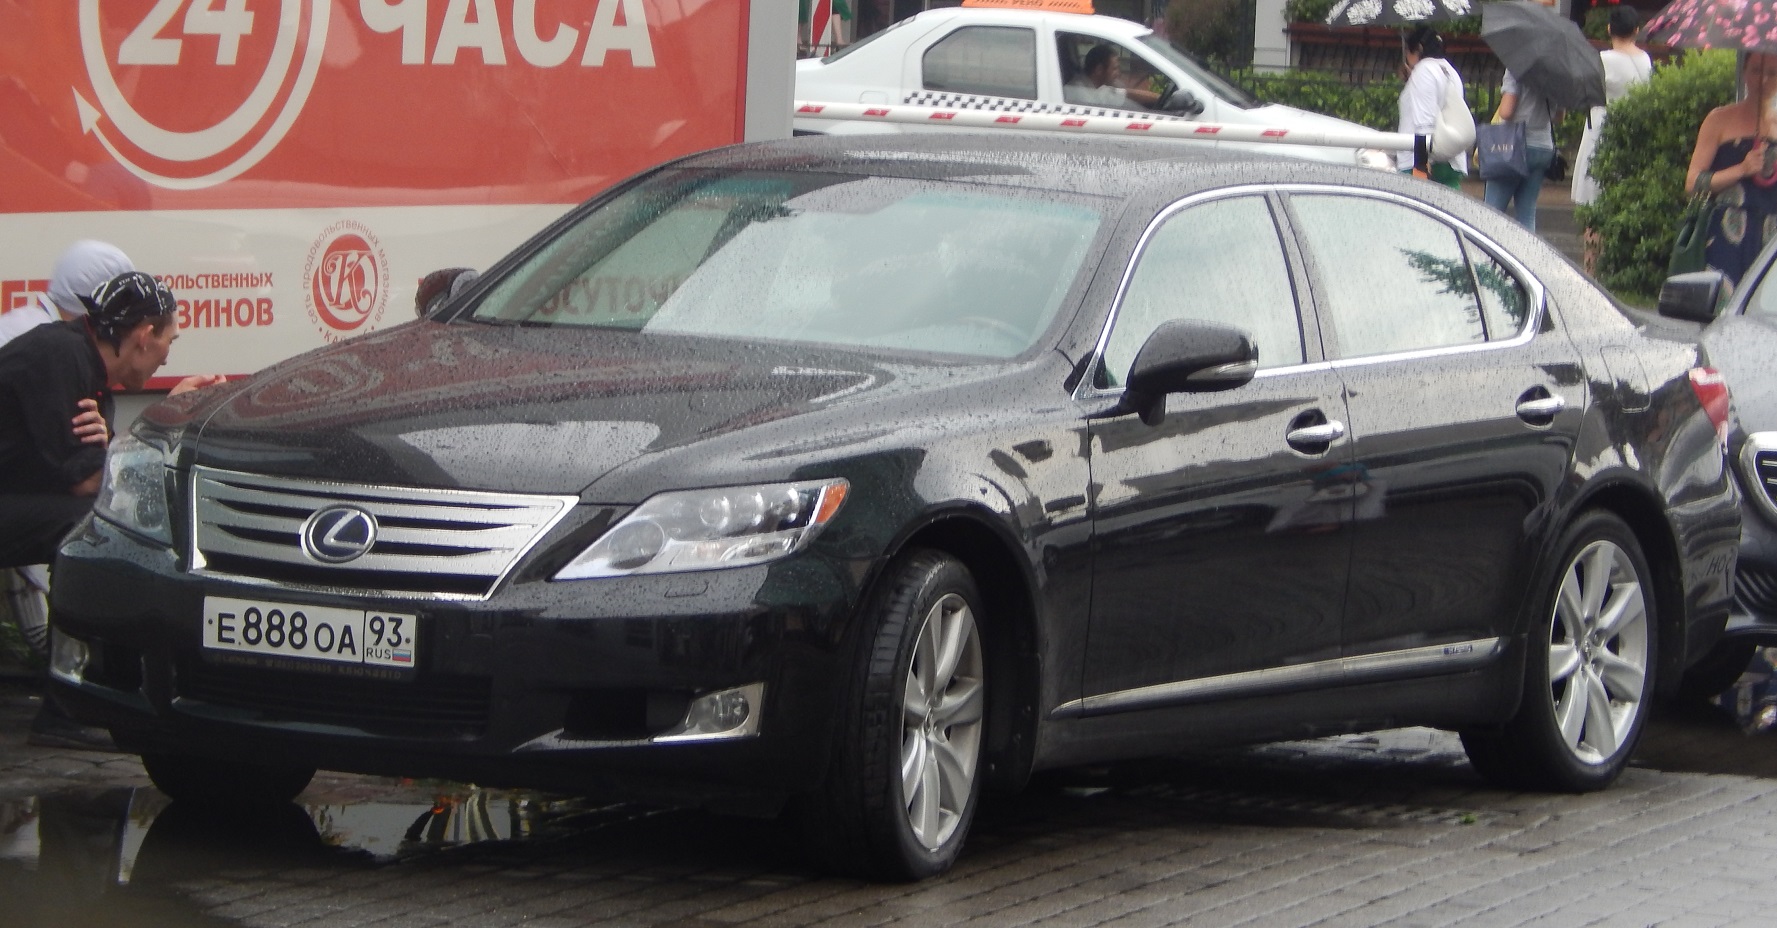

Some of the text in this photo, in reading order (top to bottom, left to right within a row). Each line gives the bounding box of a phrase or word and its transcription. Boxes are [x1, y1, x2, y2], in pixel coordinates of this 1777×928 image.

[359, 0, 656, 68] ЧАСА
[302, 219, 380, 289] продовольственных
[374, 248, 390, 322] магазинов
[365, 647, 391, 660] RUS
[369, 615, 404, 648] 93
